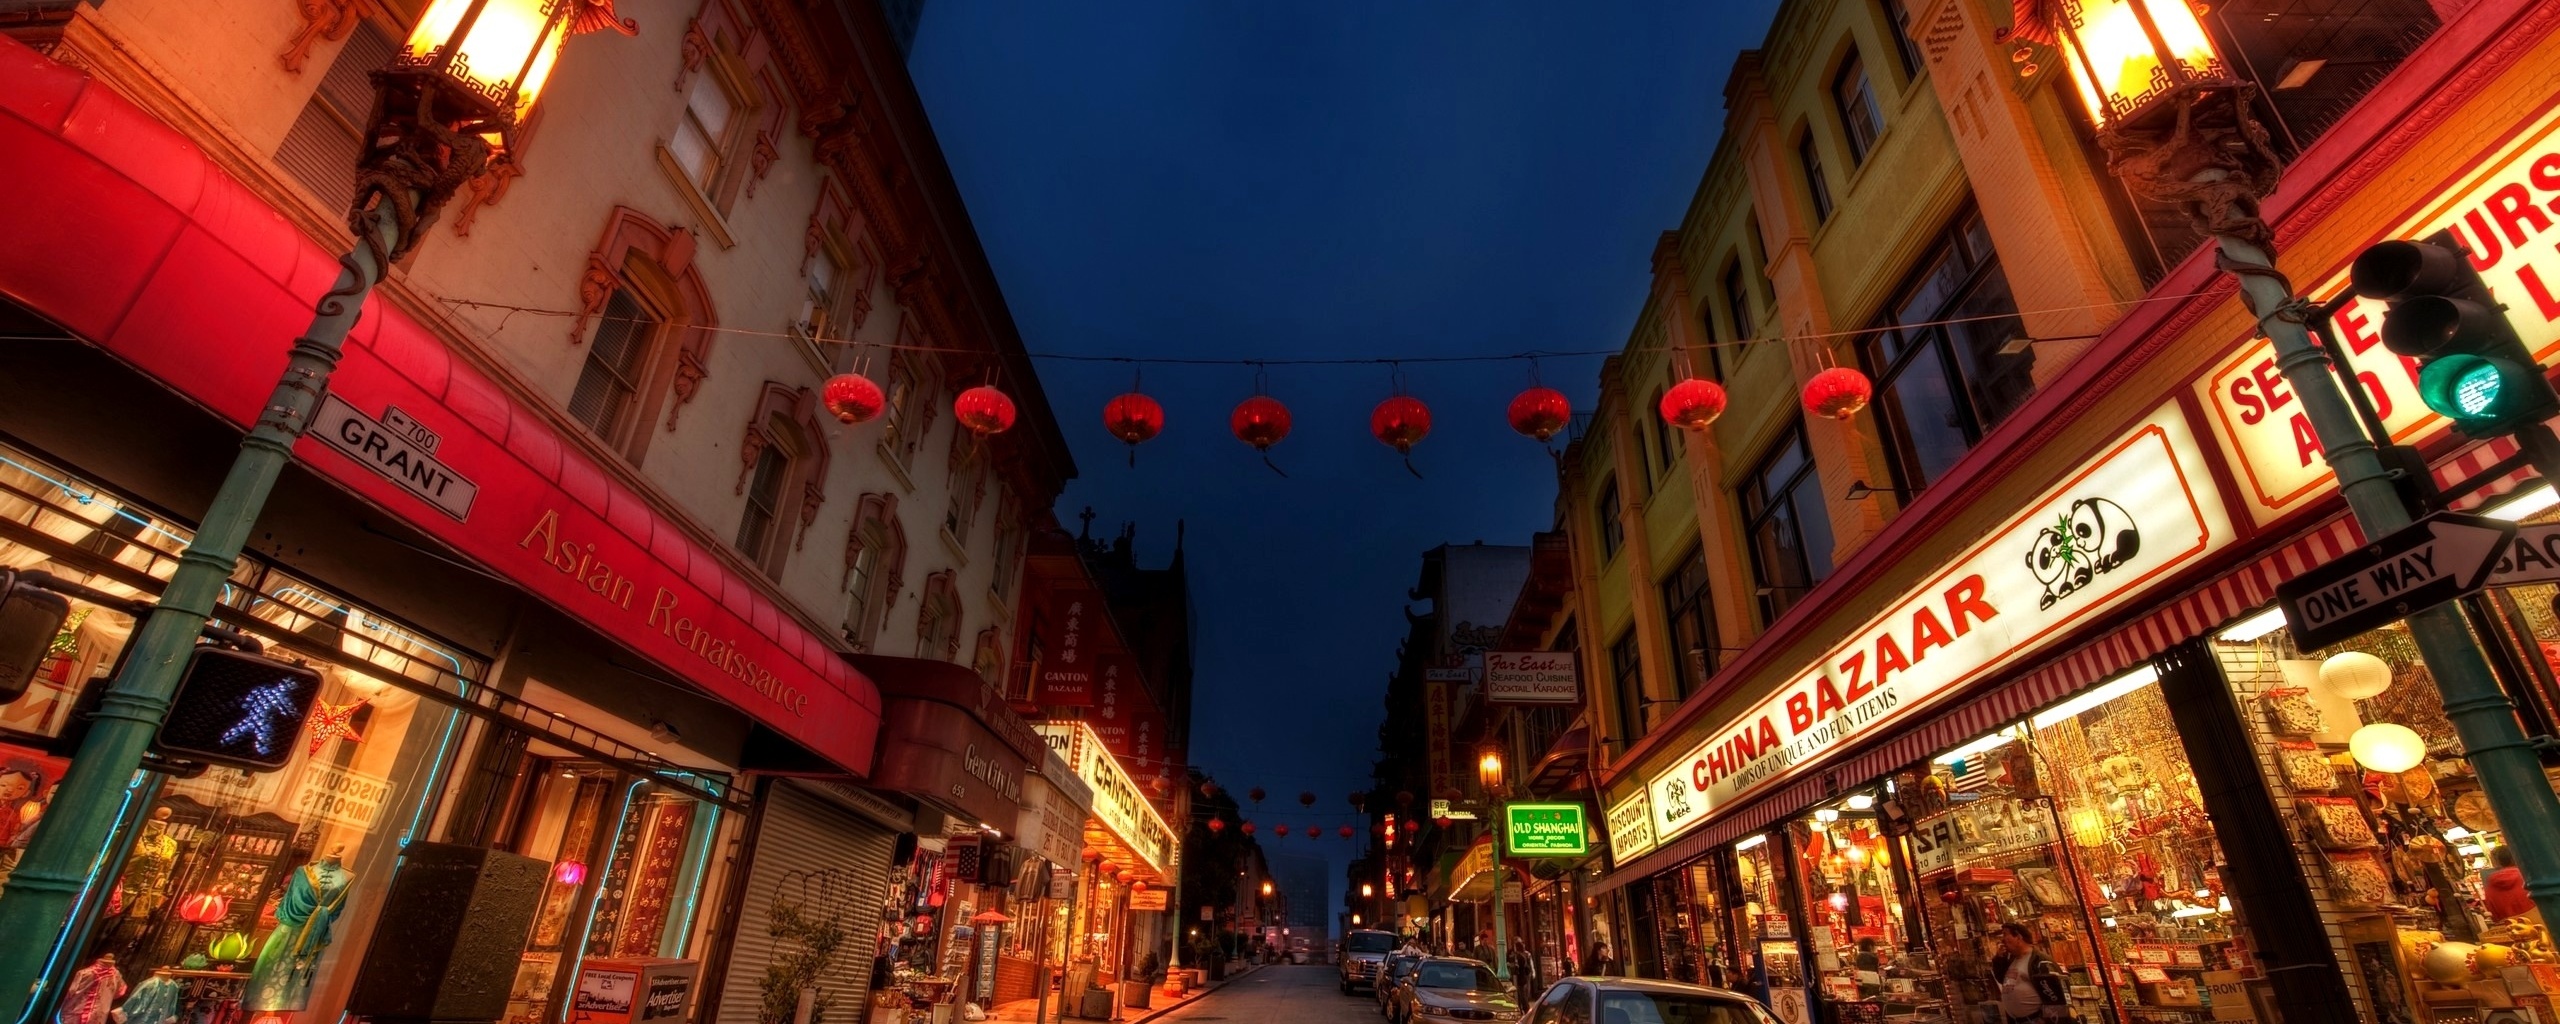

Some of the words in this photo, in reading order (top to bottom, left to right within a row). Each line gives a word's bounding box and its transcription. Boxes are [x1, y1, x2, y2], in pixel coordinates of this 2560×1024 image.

[407, 422, 434, 449] 700
[340, 418, 453, 497] GRANT
[2305, 580, 2367, 624] ONE
[2369, 546, 2437, 596] WAY
[519, 509, 635, 611] Asian
[648, 586, 808, 718] Renaissance
[1489, 654, 1516, 671] Far
[1518, 655, 1555, 671] East
[1045, 672, 1089, 683] CANTON
[1048, 685, 1083, 693] BAZAAR
[1533, 683, 1575, 693] KARAOKE
[1692, 715, 1781, 793] CHINA
[1786, 573, 2000, 737] BAZAAR
[1095, 726, 1126, 736] ANTON
[1755, 765, 1767, 784] OF
[1767, 746, 1805, 773] UNIQUE
[1806, 731, 1829, 753] AND
[1829, 711, 1855, 740] FUN
[1855, 687, 1898, 726] ITEMS
[964, 743, 987, 782] Gem
[987, 759, 1005, 801] City
[951, 784, 966, 799] 658
[1094, 754, 1139, 825] CANTON
[1514, 822, 1532, 834] OLD
[1533, 822, 1579, 834] SHANGHAI
[1610, 797, 1646, 836] DISCOUNT
[1616, 823, 1648, 856] IMPORTS
[646, 989, 685, 1008] Advertiser
[2207, 981, 2243, 996] FRONT
